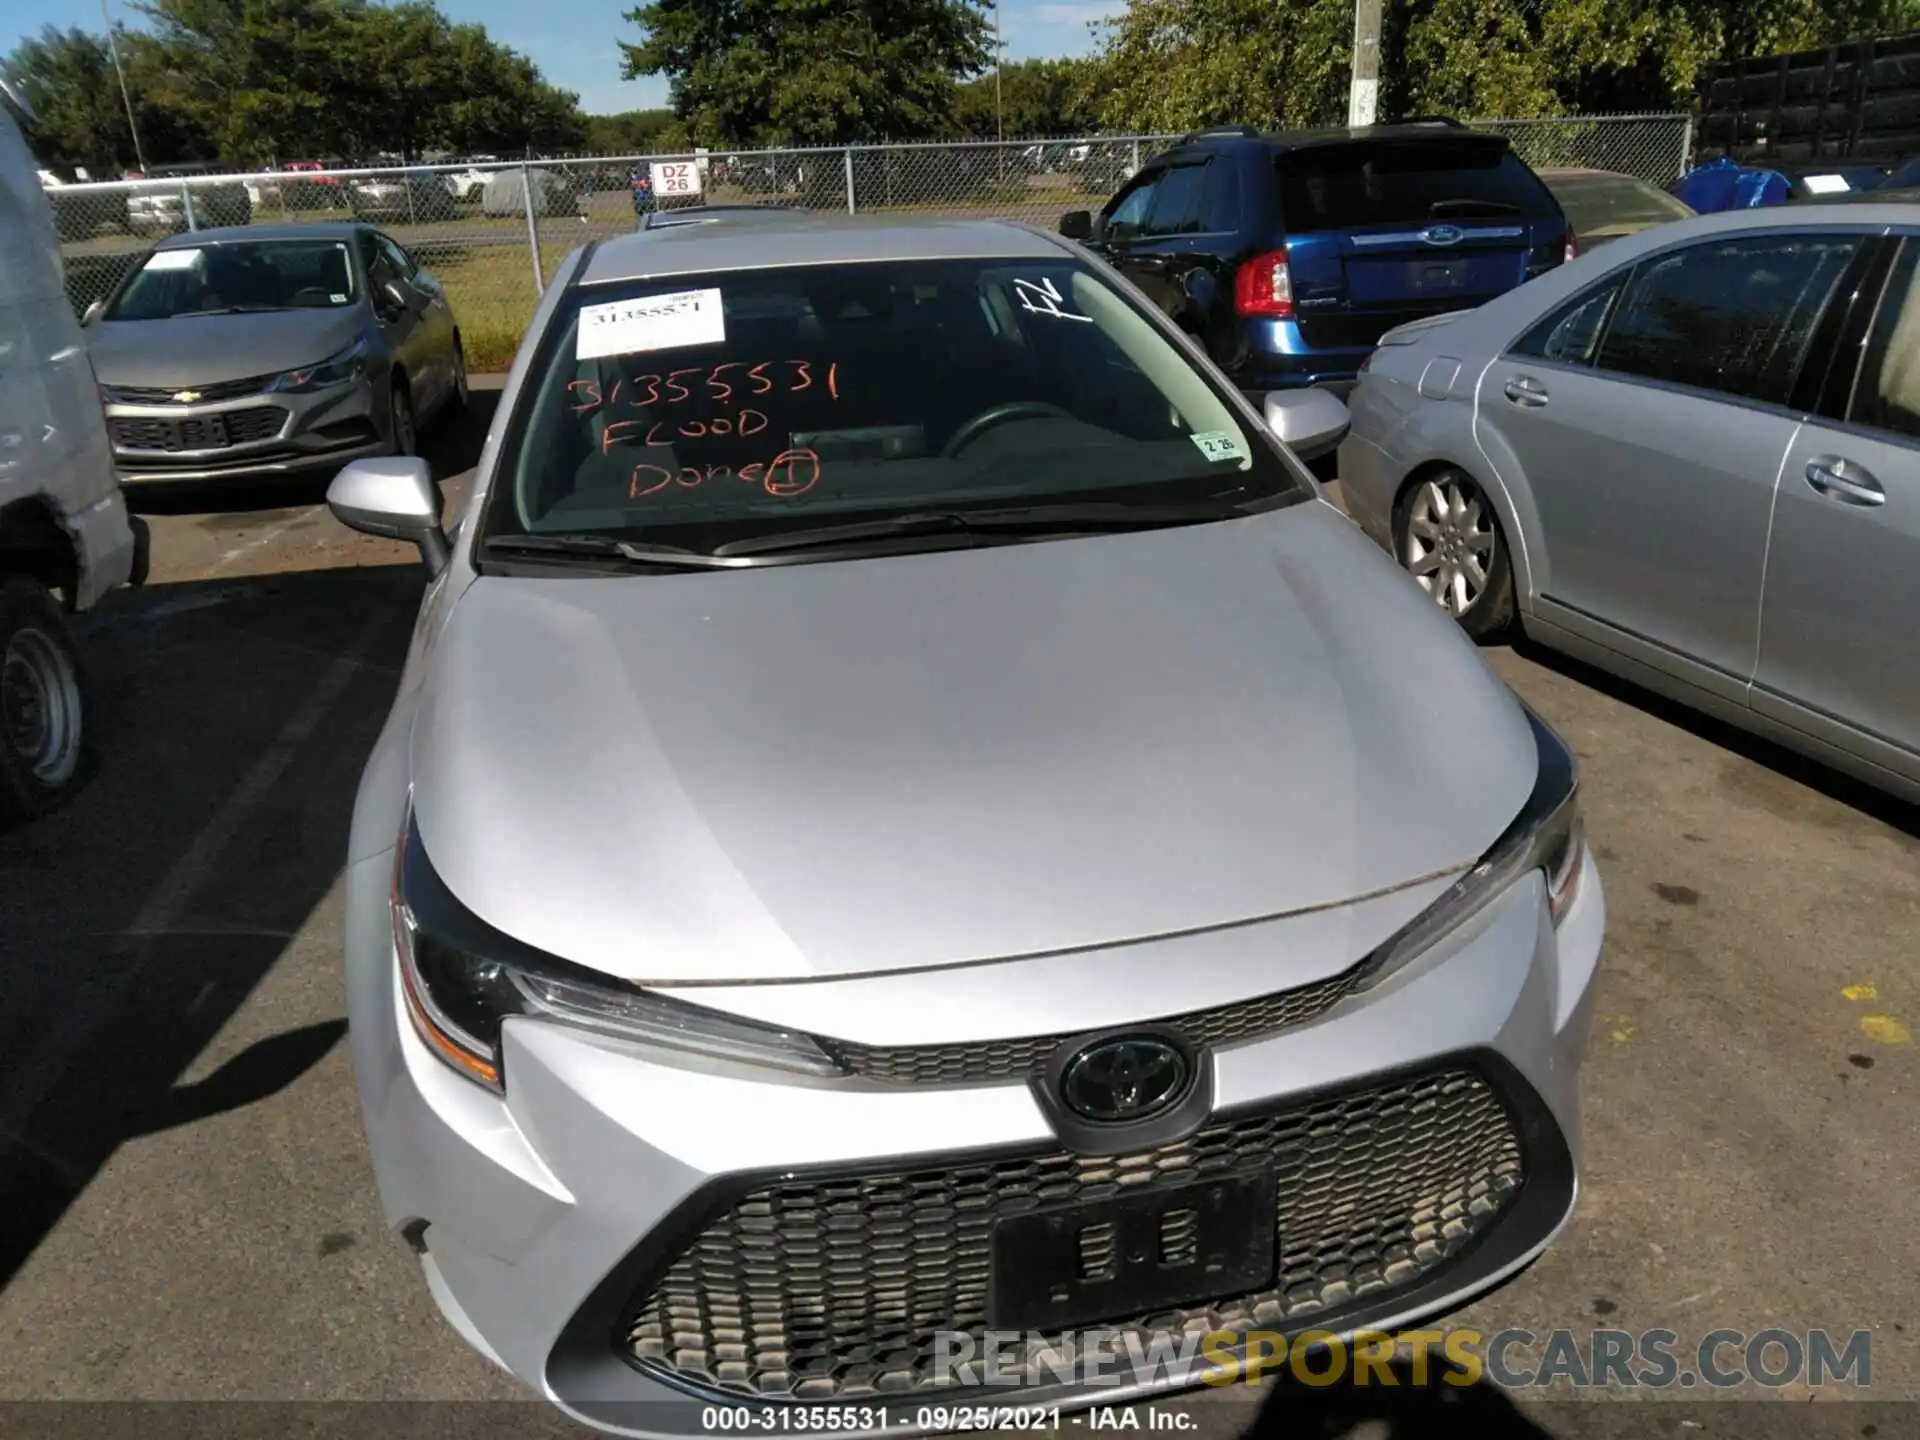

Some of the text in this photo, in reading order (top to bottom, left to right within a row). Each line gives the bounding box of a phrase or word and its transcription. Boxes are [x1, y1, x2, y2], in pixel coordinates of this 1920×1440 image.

[662, 164, 689, 178] DZ
[666, 178, 689, 191] 26
[567, 360, 841, 411] 31355531
[602, 409, 769, 456] FLOOD
